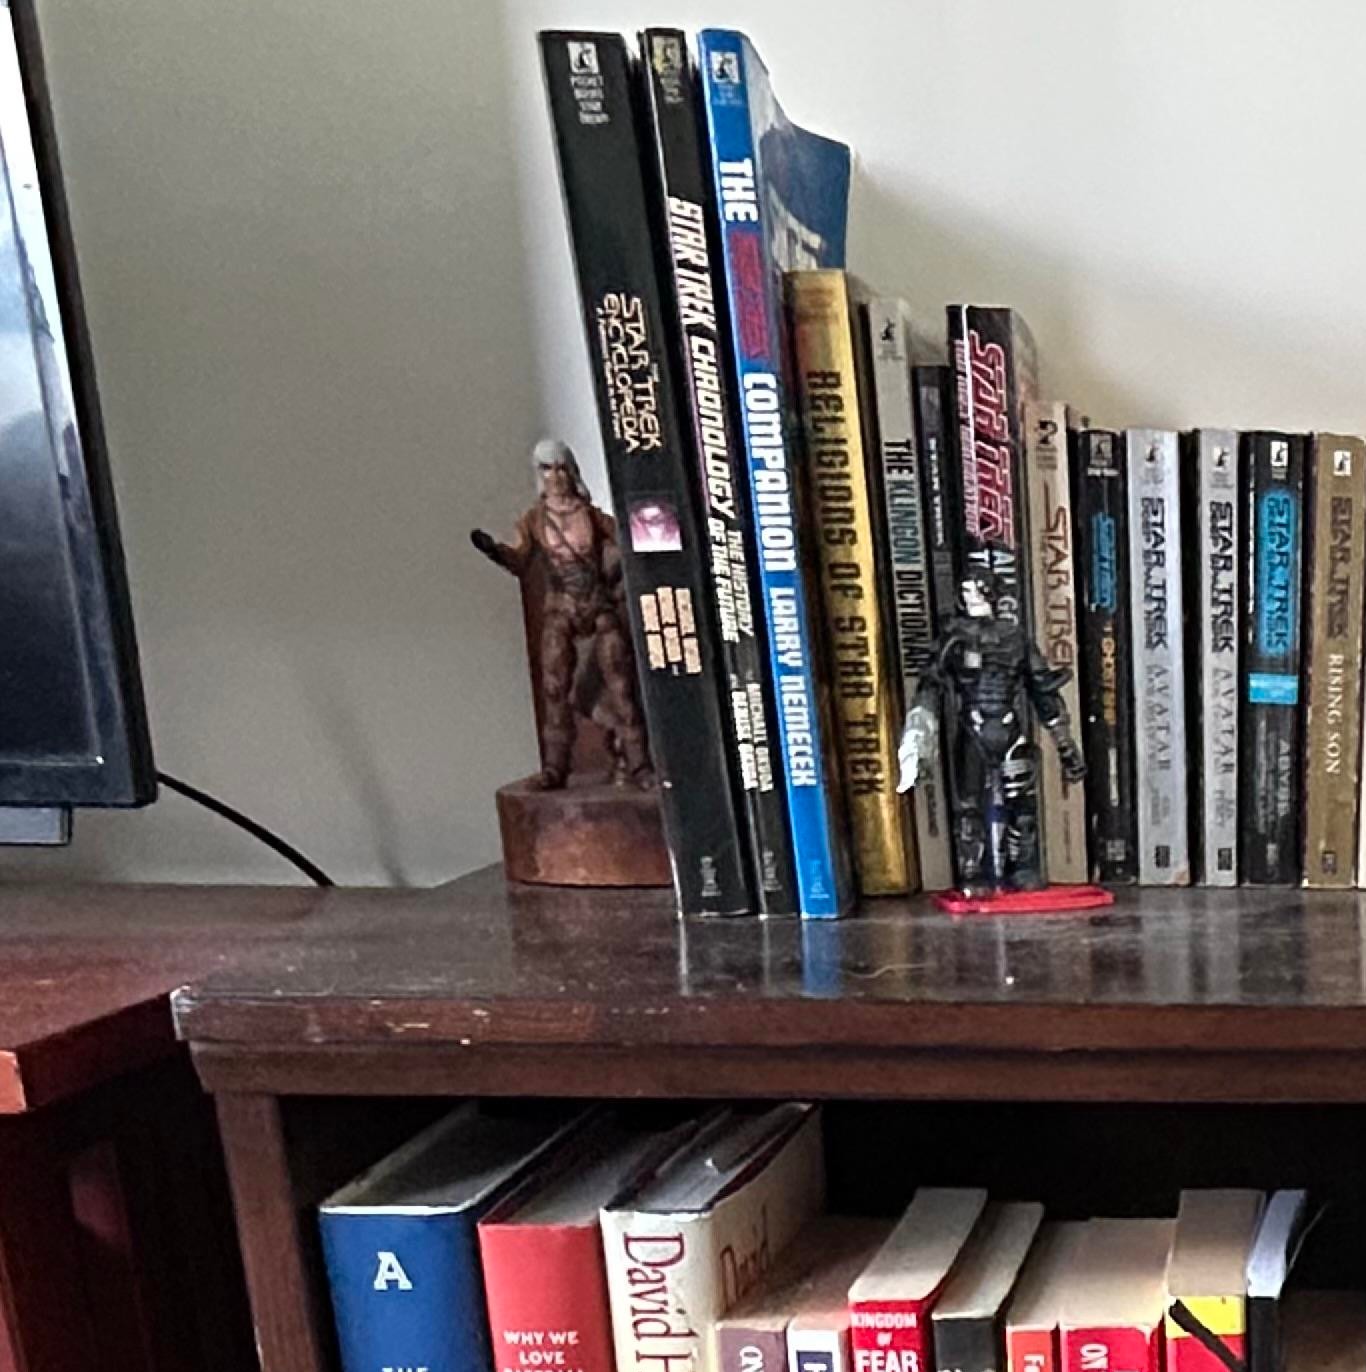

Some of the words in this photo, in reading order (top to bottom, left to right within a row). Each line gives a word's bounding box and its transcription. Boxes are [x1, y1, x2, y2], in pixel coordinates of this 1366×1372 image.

[719, 157, 758, 223] THE
[667, 196, 709, 268] STAR
[619, 293, 649, 370] STAR
[675, 264, 716, 332] TREK
[603, 293, 640, 454] ENCYCLOPEDIA
[969, 329, 1009, 441] STAR
[633, 375, 662, 451] TREK
[690, 336, 736, 519] CHRONOLOGY
[743, 373, 797, 571] COMPANION
[807, 371, 857, 547] RELIGIONS
[884, 439, 914, 478] THE
[974, 440, 1015, 549] TREK
[887, 480, 921, 565] KLINGON
[1044, 482, 1071, 588] STAR
[1149, 497, 1166, 569] STAR
[1219, 501, 1234, 571] STAR
[1274, 497, 1292, 573] STAR
[715, 575, 740, 643] FUTURE
[828, 562, 864, 600] OF
[1149, 577, 1168, 650] TREK
[1273, 577, 1290, 649] TREK
[769, 587, 803, 667] LARRY
[1219, 582, 1235, 653] TREK
[836, 617, 876, 700] STAR
[1327, 653, 1345, 724] RISING
[780, 675, 818, 787] NEMECEK
[845, 713, 884, 796] TREK
[1220, 667, 1236, 774] AVATAR
[1325, 732, 1342, 775] SON
[373, 1251, 413, 1291] A
[623, 1231, 700, 1341] David
[502, 1330, 545, 1346] WHY
[548, 1331, 580, 1346] WE
[851, 1312, 918, 1328] KINGDOM
[875, 1331, 893, 1347] OF
[518, 1350, 566, 1366] LOVE
[1079, 1342, 1109, 1371] ON
